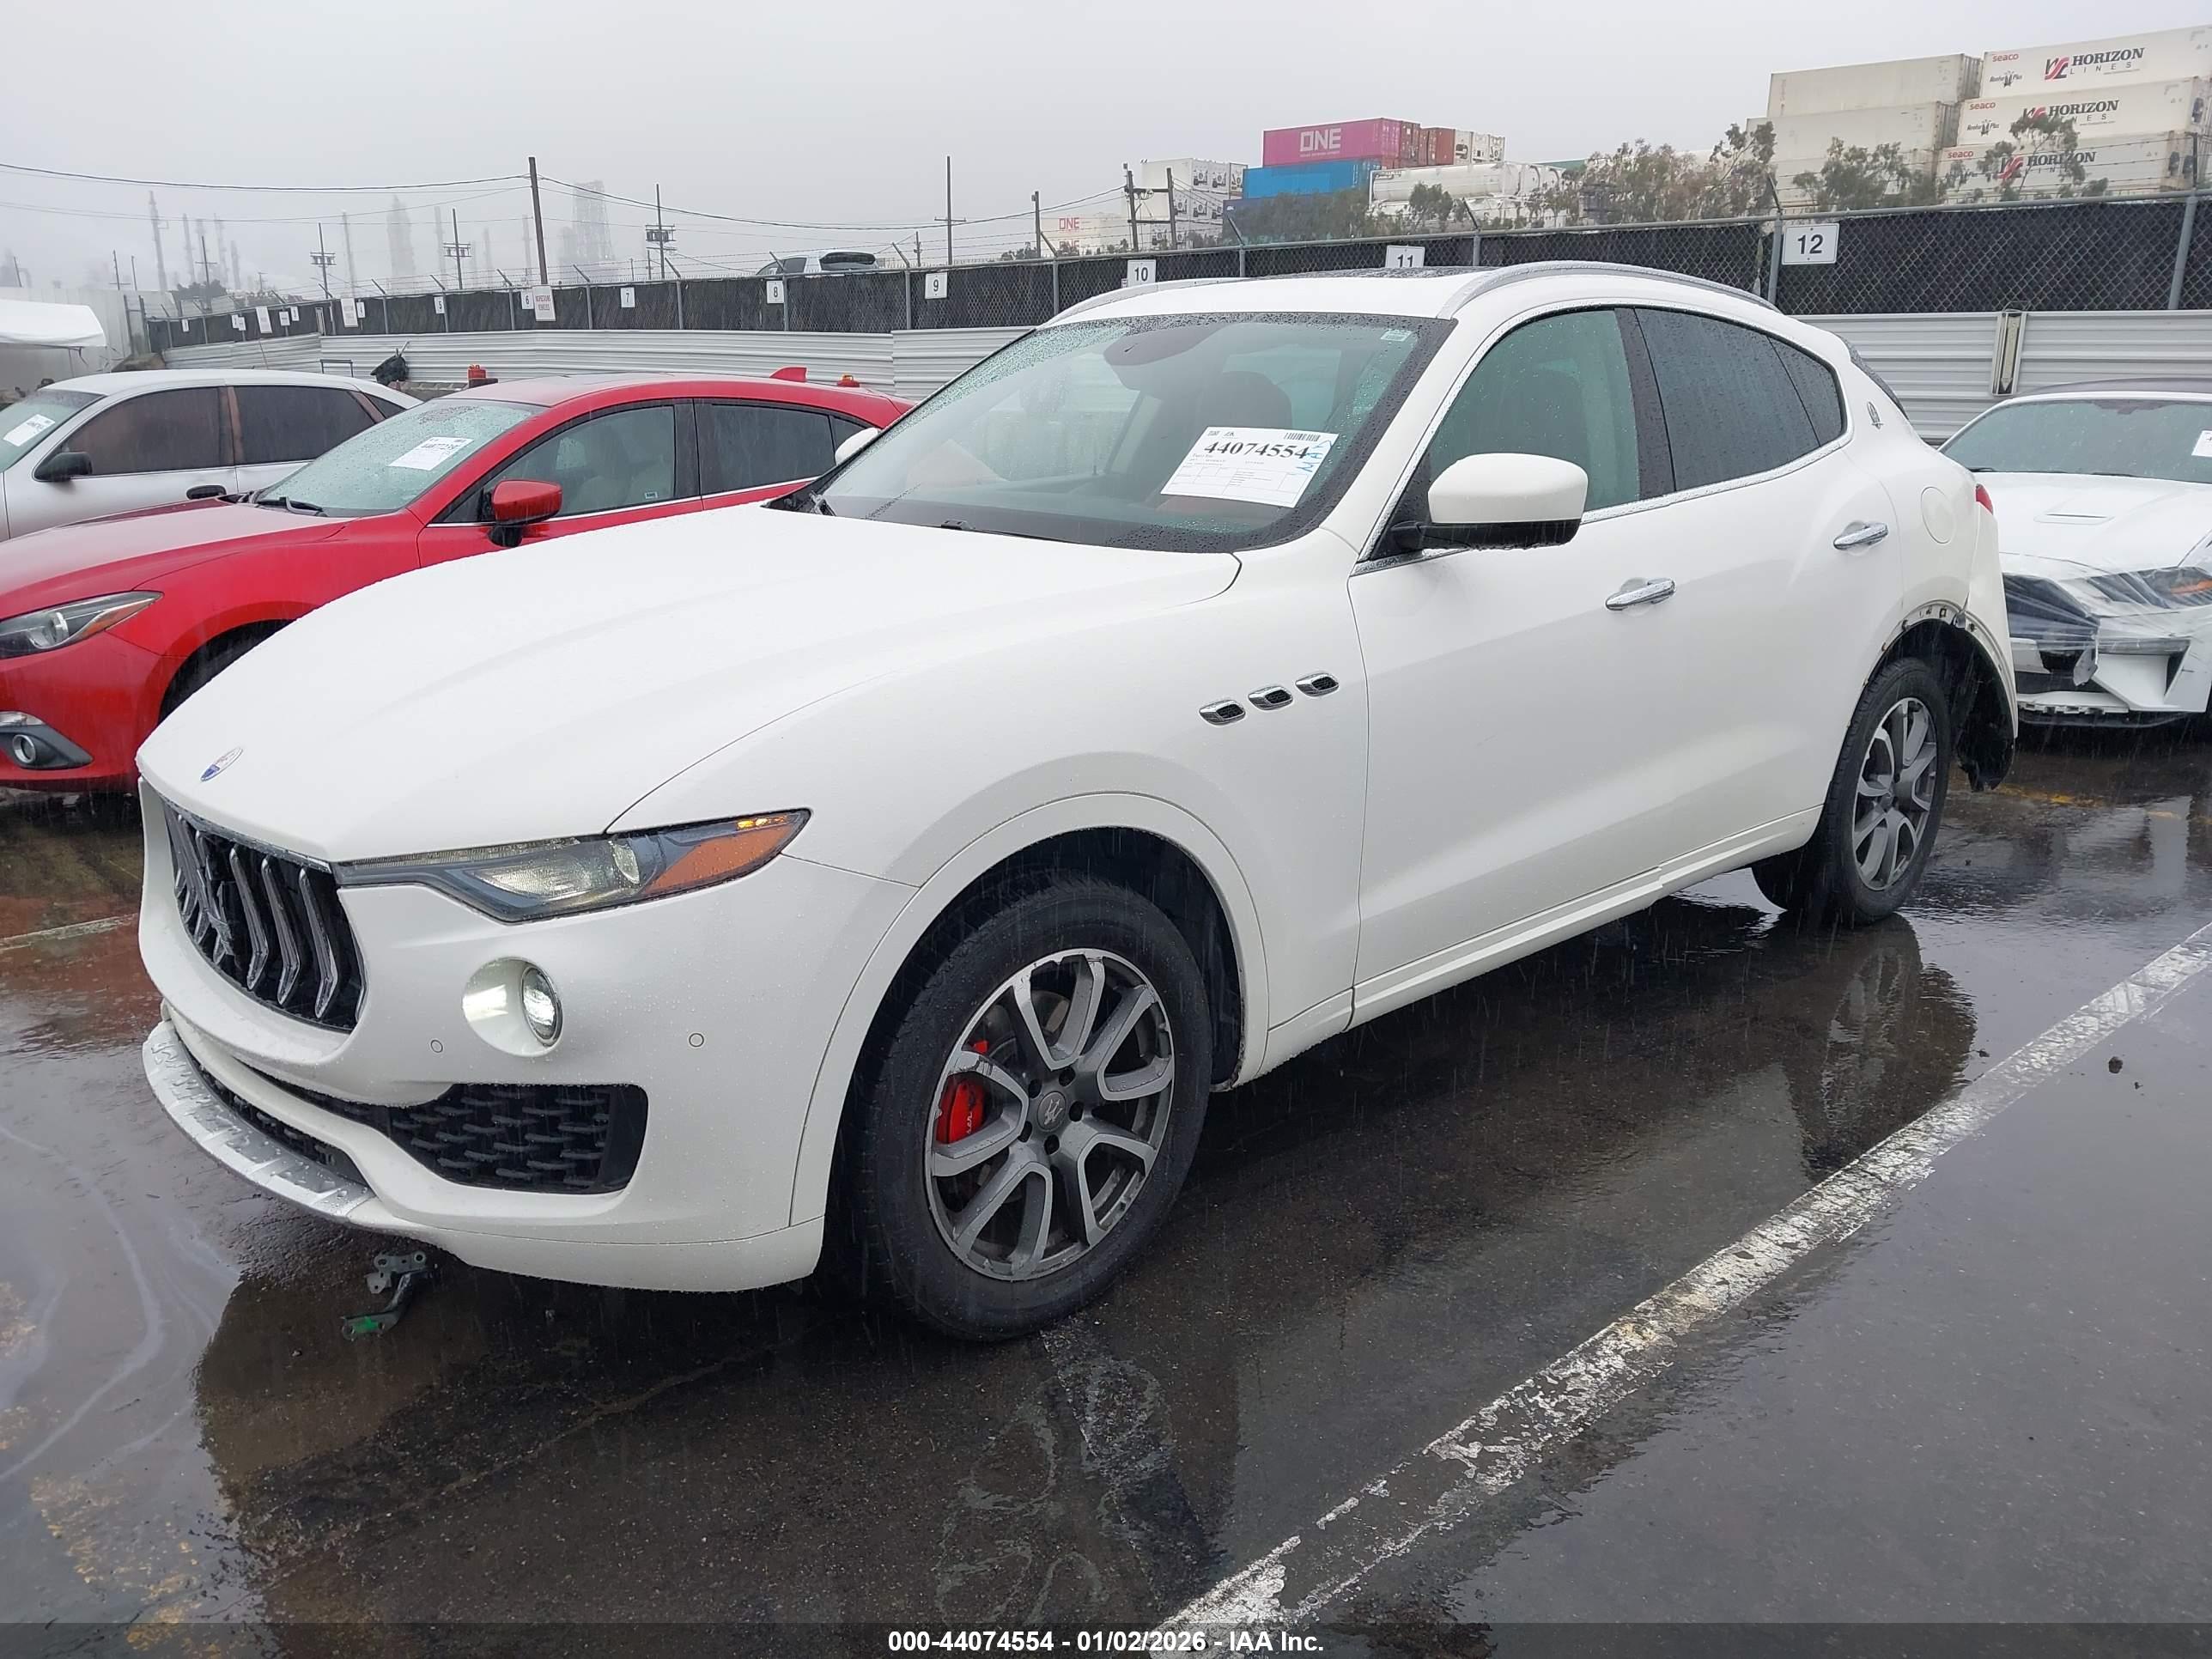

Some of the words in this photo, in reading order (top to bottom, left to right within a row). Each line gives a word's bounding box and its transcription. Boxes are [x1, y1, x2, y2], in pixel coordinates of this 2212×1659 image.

[2072, 48, 2144, 66] HORIZON
[2070, 62, 2132, 75] LINES
[2049, 100, 2120, 117] HORIZON
[1300, 128, 1341, 152] ONE
[1948, 150, 1974, 159] seaco
[1059, 217, 1080, 230] ONE
[1797, 234, 1824, 255] 12
[1397, 253, 1414, 269] 11
[1134, 267, 1149, 282] 10
[773, 286, 779, 298] 8
[933, 278, 940, 292] 9
[526, 295, 530, 305] 6
[625, 292, 630, 303] 7
[1204, 441, 1310, 459] 44074554
